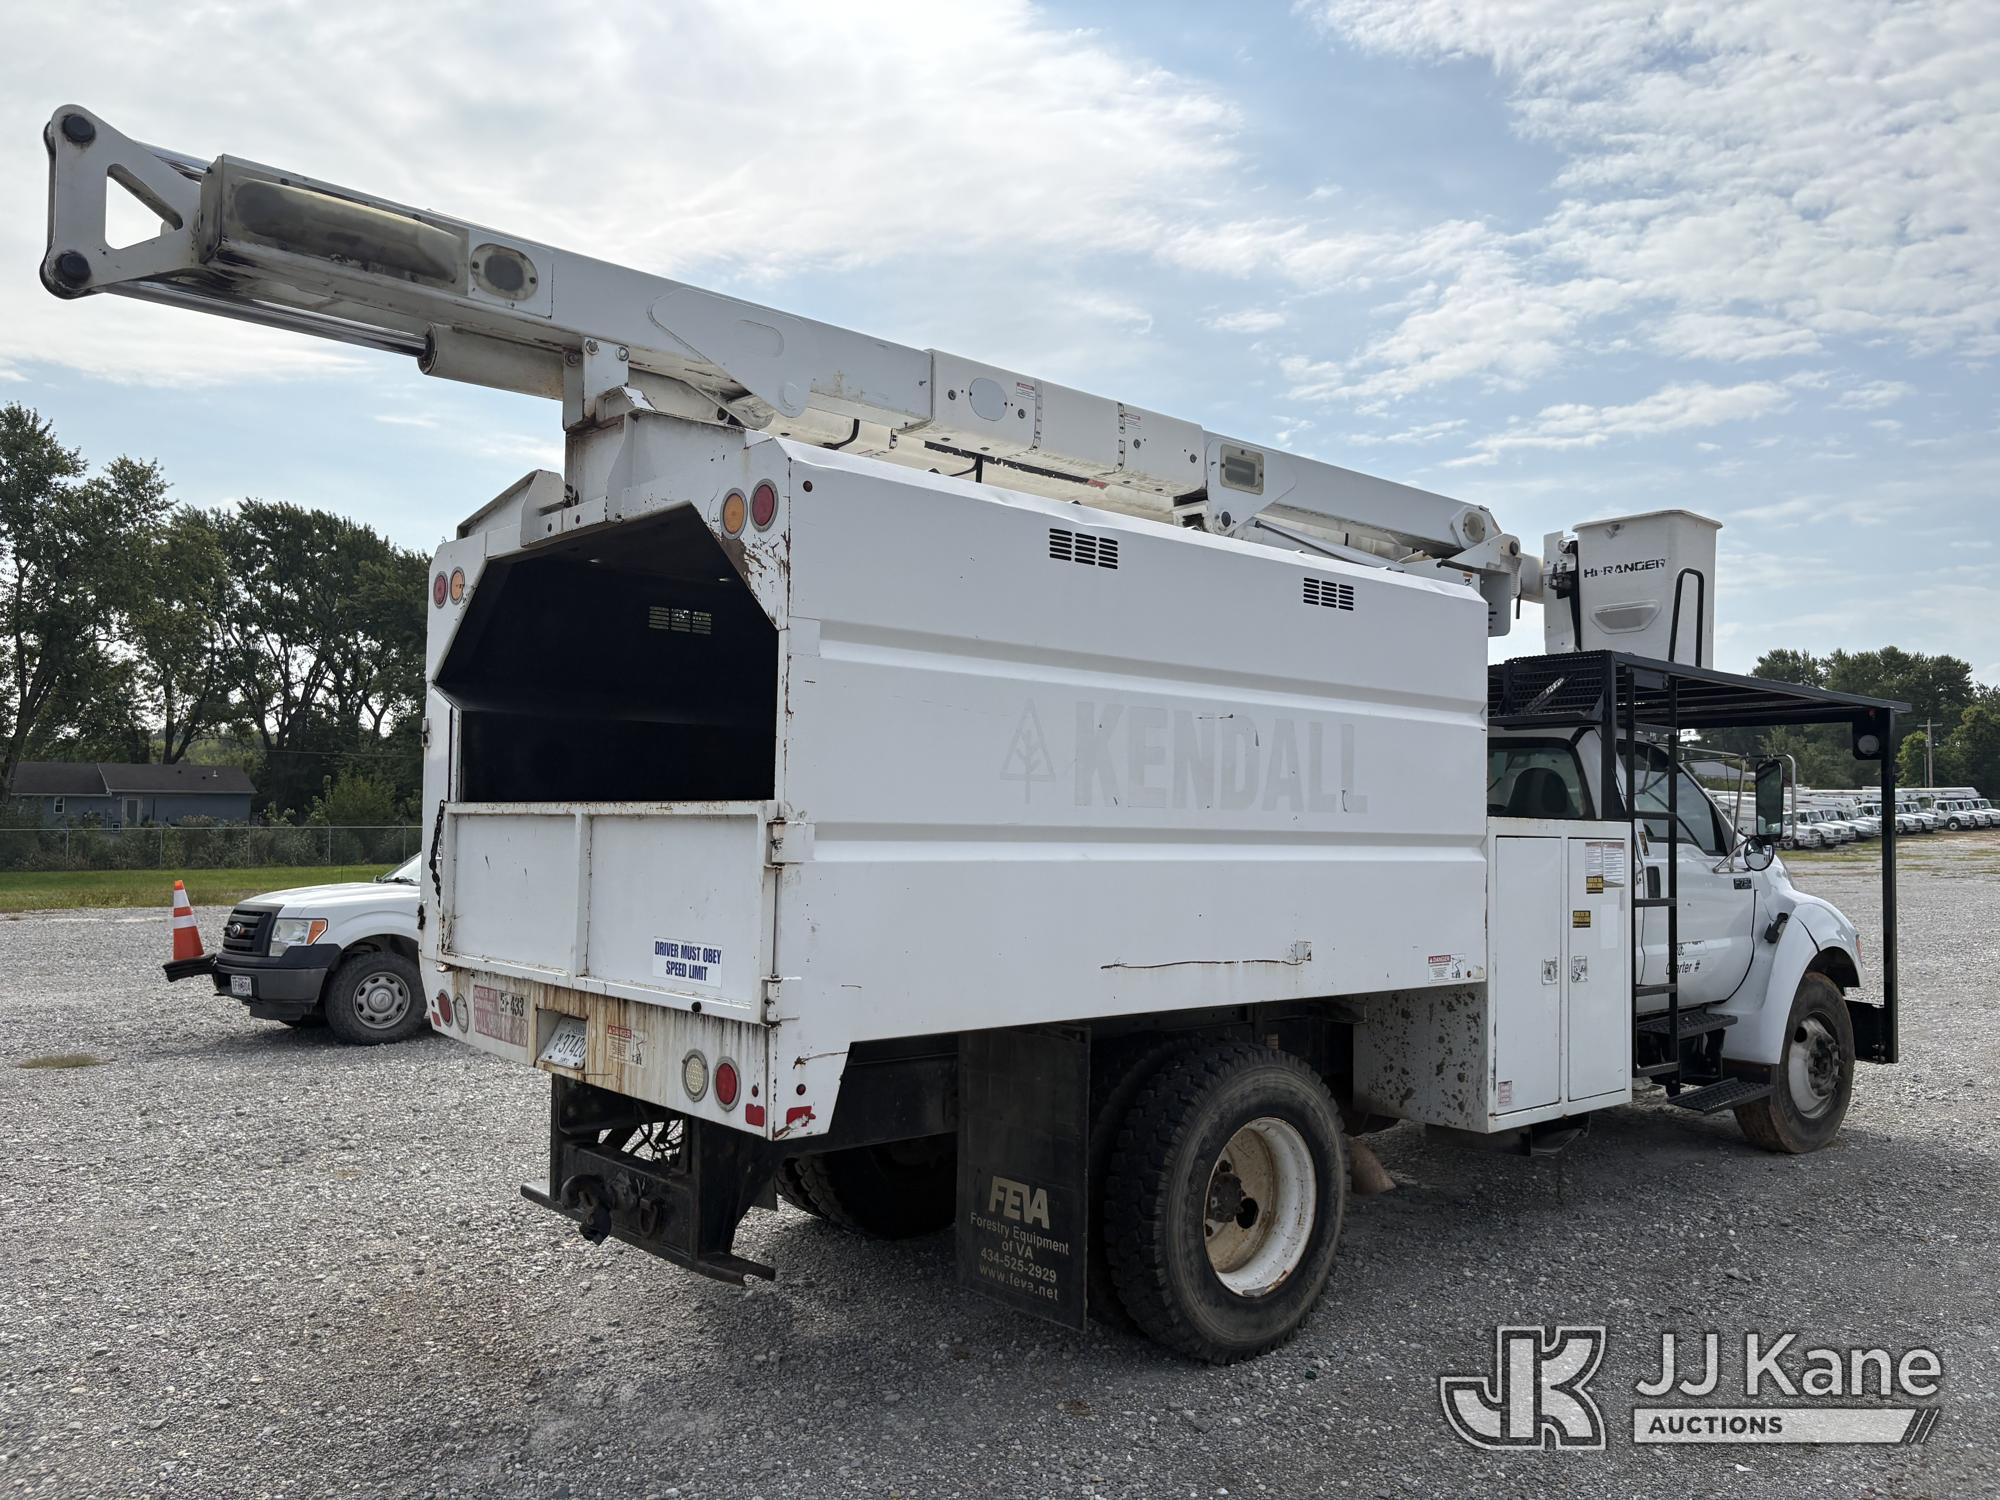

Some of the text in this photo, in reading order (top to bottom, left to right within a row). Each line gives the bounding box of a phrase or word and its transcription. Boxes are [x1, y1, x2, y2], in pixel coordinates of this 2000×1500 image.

[1072, 701, 1368, 813] KENDALL
[654, 941, 722, 965] DRIVER MUST OBEY
[665, 960, 708, 981] SPEED LIMIT
[510, 995, 525, 1017] 433
[988, 1175, 1050, 1230] FEVA
[970, 1212, 1070, 1256] Forestry Equipment
[1001, 1240, 1034, 1259] of VA
[978, 1264, 1059, 1301] www.feva.net
[980, 1247, 1057, 1283] 434-525-2929
